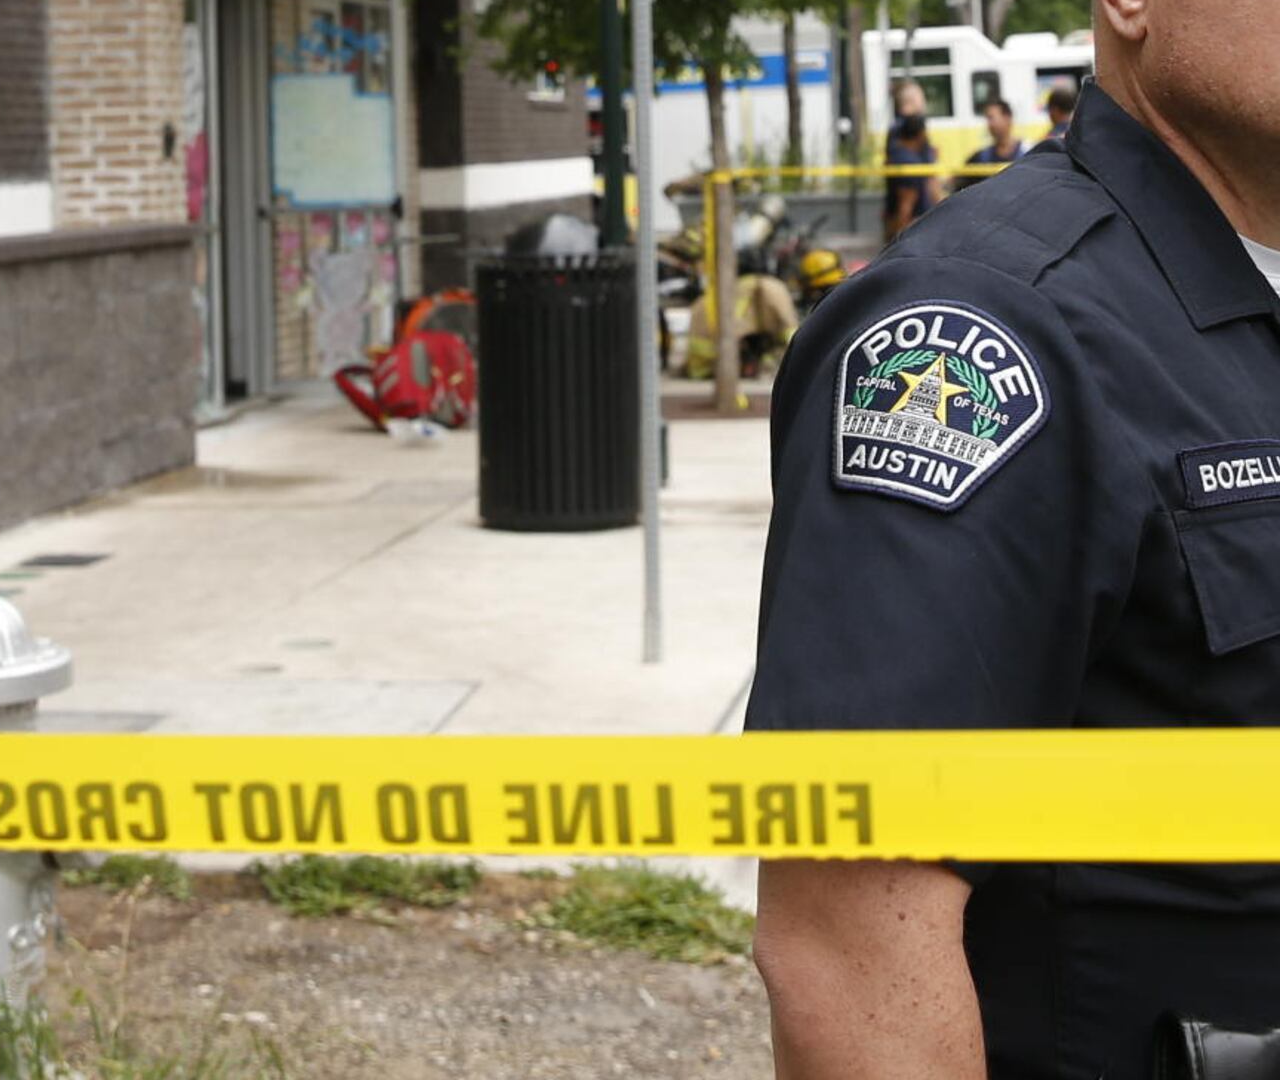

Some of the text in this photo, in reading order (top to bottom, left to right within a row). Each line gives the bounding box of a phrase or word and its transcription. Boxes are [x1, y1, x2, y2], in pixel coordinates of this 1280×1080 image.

[861, 316, 1030, 403] POLICE
[953, 396, 1010, 426] OF TEXAS
[846, 444, 958, 490] AUSTIN
